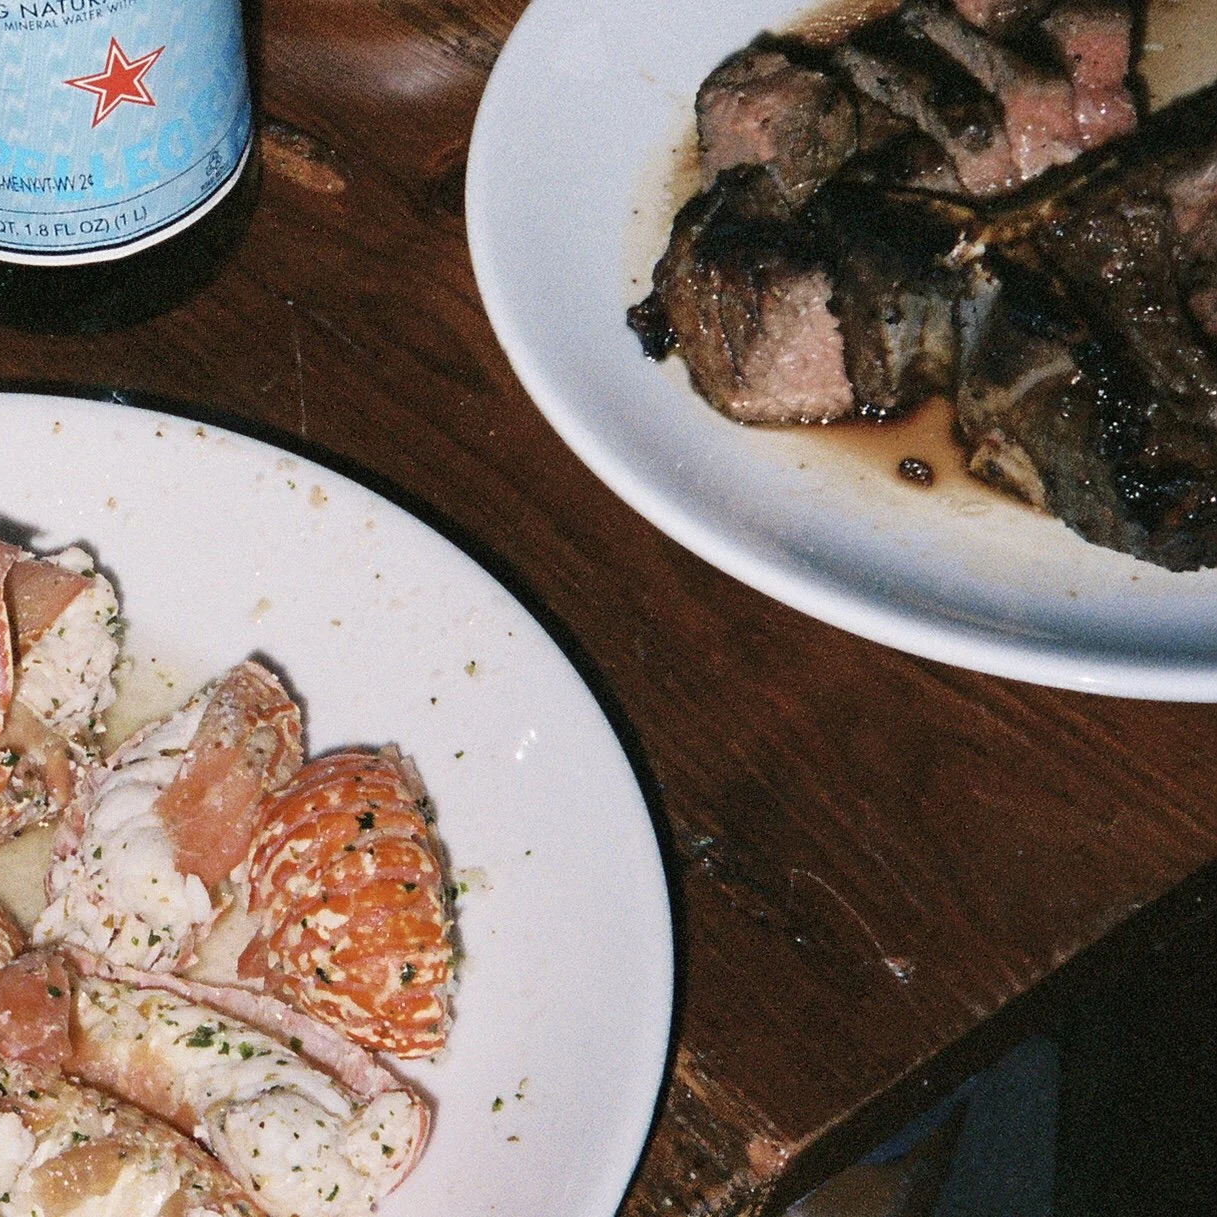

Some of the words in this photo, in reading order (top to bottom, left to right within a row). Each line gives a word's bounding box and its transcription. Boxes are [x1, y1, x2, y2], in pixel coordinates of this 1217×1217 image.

[4, 17, 58, 31] MINERAL
[63, 9, 104, 26] WATER
[26, 224, 49, 237] 1.8
[54, 224, 73, 237] FL
[80, 218, 110, 234] OZ)
[114, 214, 127, 231] (1
[134, 206, 148, 221] L)
